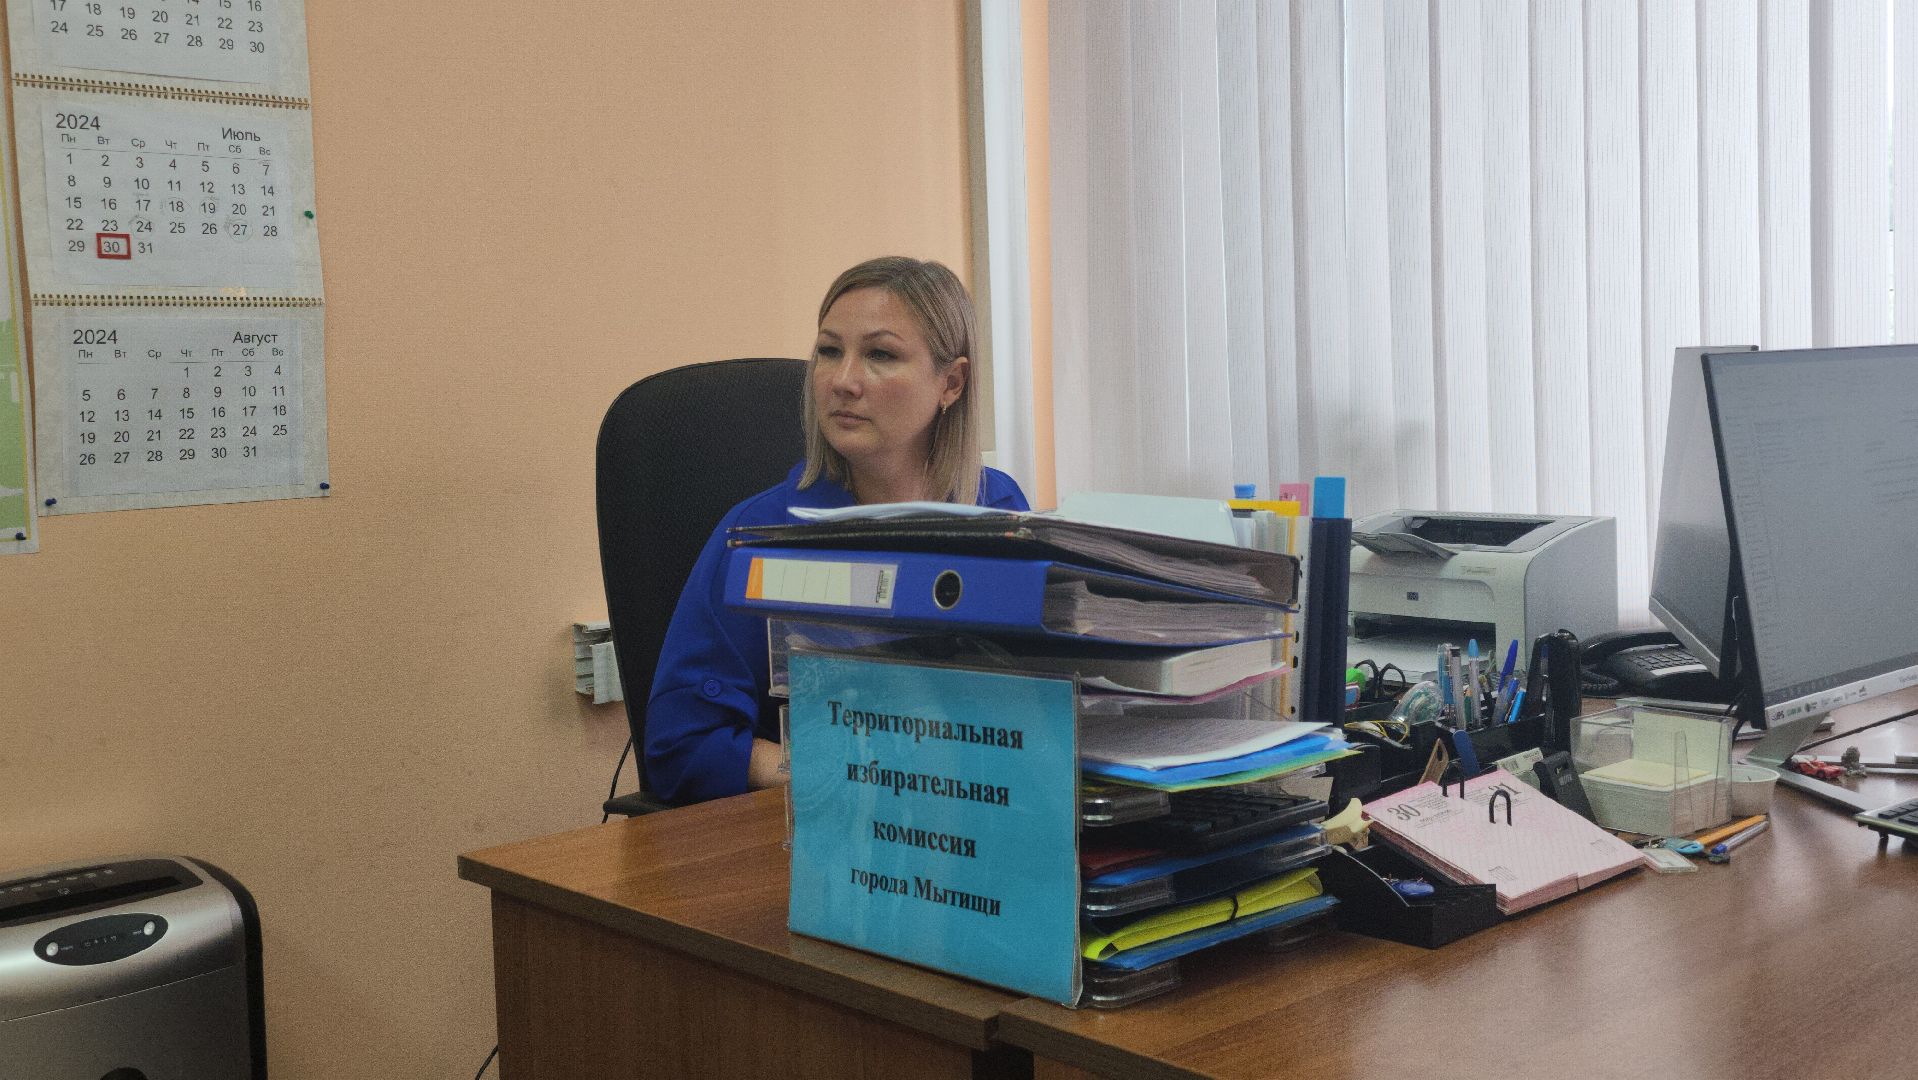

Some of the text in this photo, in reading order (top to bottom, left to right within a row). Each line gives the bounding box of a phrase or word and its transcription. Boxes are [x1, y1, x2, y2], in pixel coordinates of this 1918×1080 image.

[218, 0, 262, 12] 15 16
[51, 0, 263, 33] 17 18 19 20 21 22 23
[51, 21, 265, 54] 24 25 26 27 28 29 30
[55, 114, 101, 130] 2024
[61, 133, 271, 156] Пн Вт Ср Чт Пт Сб Вс
[66, 154, 270, 176] 1 2 3 4 5 6 7
[67, 175, 275, 197] 8 9 10 11 12 13 14
[65, 197, 276, 217] 15 16 17 18 19 20 21
[66, 219, 278, 237] 22 23 24 25 26 27 28
[68, 240, 153, 254] 29 30 31
[72, 330, 278, 345] 2024 Август
[78, 347, 284, 360] Пн Вт Ср Чт Пт Сб Вс
[184, 365, 282, 378] 1 2 3 4
[82, 385, 285, 401] 5 6 7 8 9 10 11
[80, 404, 287, 423] 12 13 14 15 16 17 18
[80, 424, 288, 444] 19 20 21 22 23 24 25
[79, 446, 258, 466] 26 27 28 29 30 31
[827, 700, 1024, 750] Территориальная
[847, 760, 1010, 807] избирательная
[1387, 803, 1421, 821] 30
[873, 819, 976, 858] комиссия
[851, 866, 1002, 917] города Мытищи
